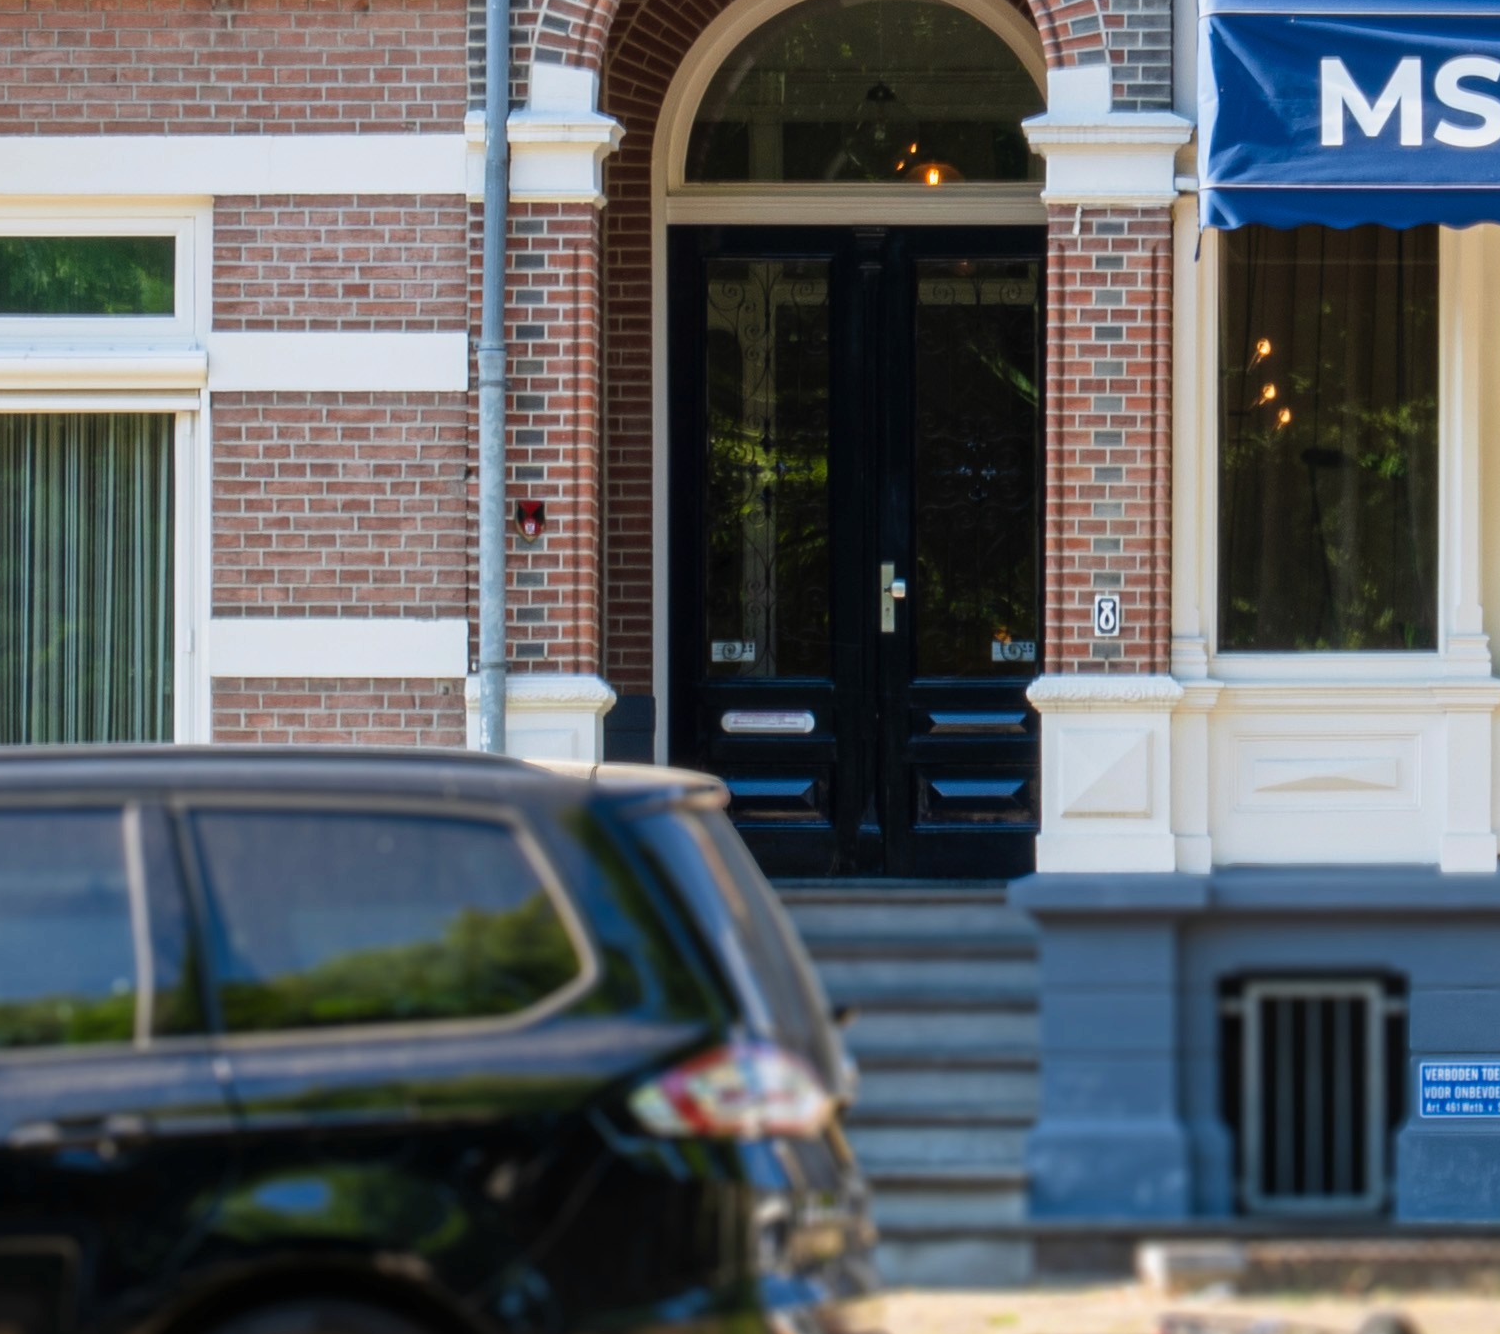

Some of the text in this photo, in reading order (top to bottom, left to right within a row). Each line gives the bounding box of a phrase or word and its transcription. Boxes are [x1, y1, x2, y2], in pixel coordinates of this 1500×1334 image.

[1099, 600, 1116, 631] 8
[1424, 1068, 1479, 1082] VERBODEN
[1423, 1086, 1452, 1099] VOOR
